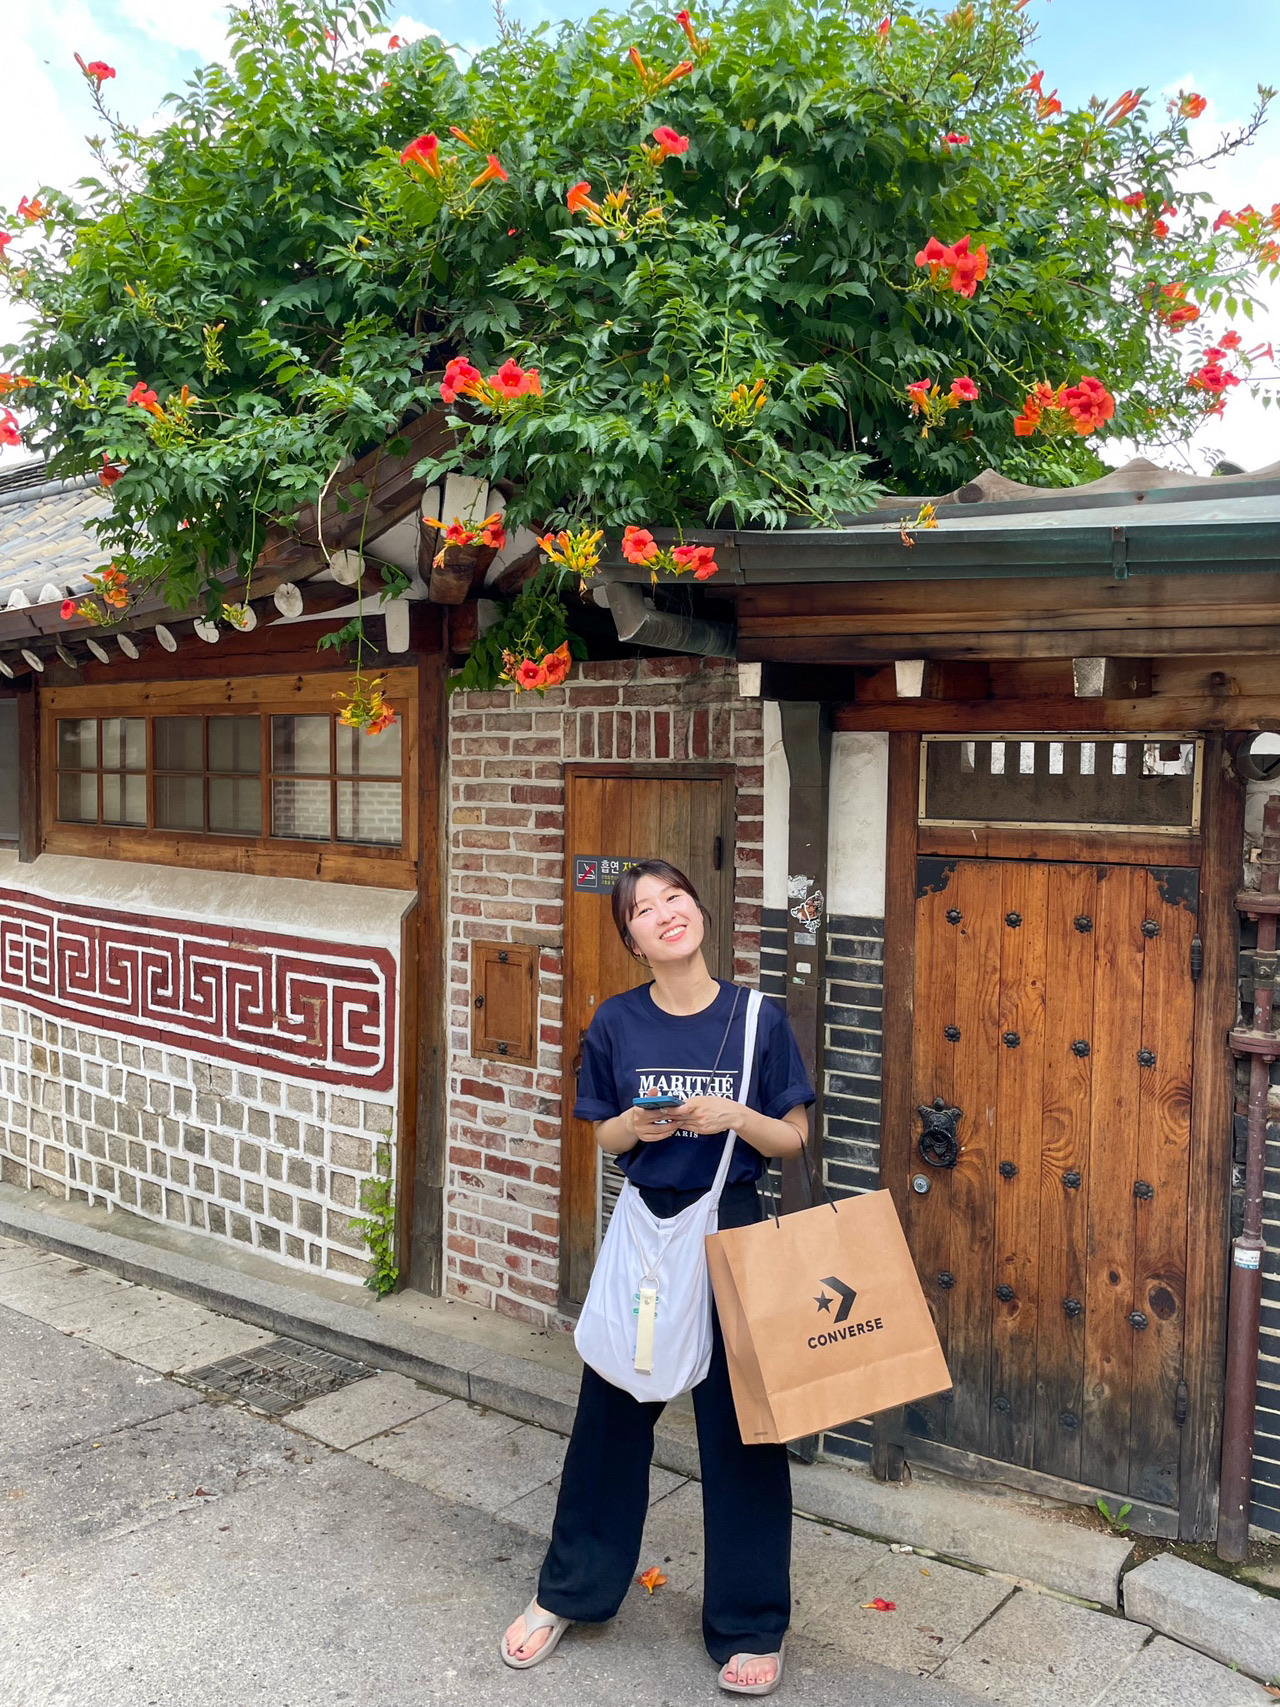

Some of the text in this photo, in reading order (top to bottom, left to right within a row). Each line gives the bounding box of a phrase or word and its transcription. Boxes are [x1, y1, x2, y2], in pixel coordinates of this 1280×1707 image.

[601, 860, 619, 874] 흡연
[640, 1074, 734, 1093] MARITHÉ
[671, 1130, 699, 1139] ARIS
[807, 1317, 884, 1349] CONVERSE
